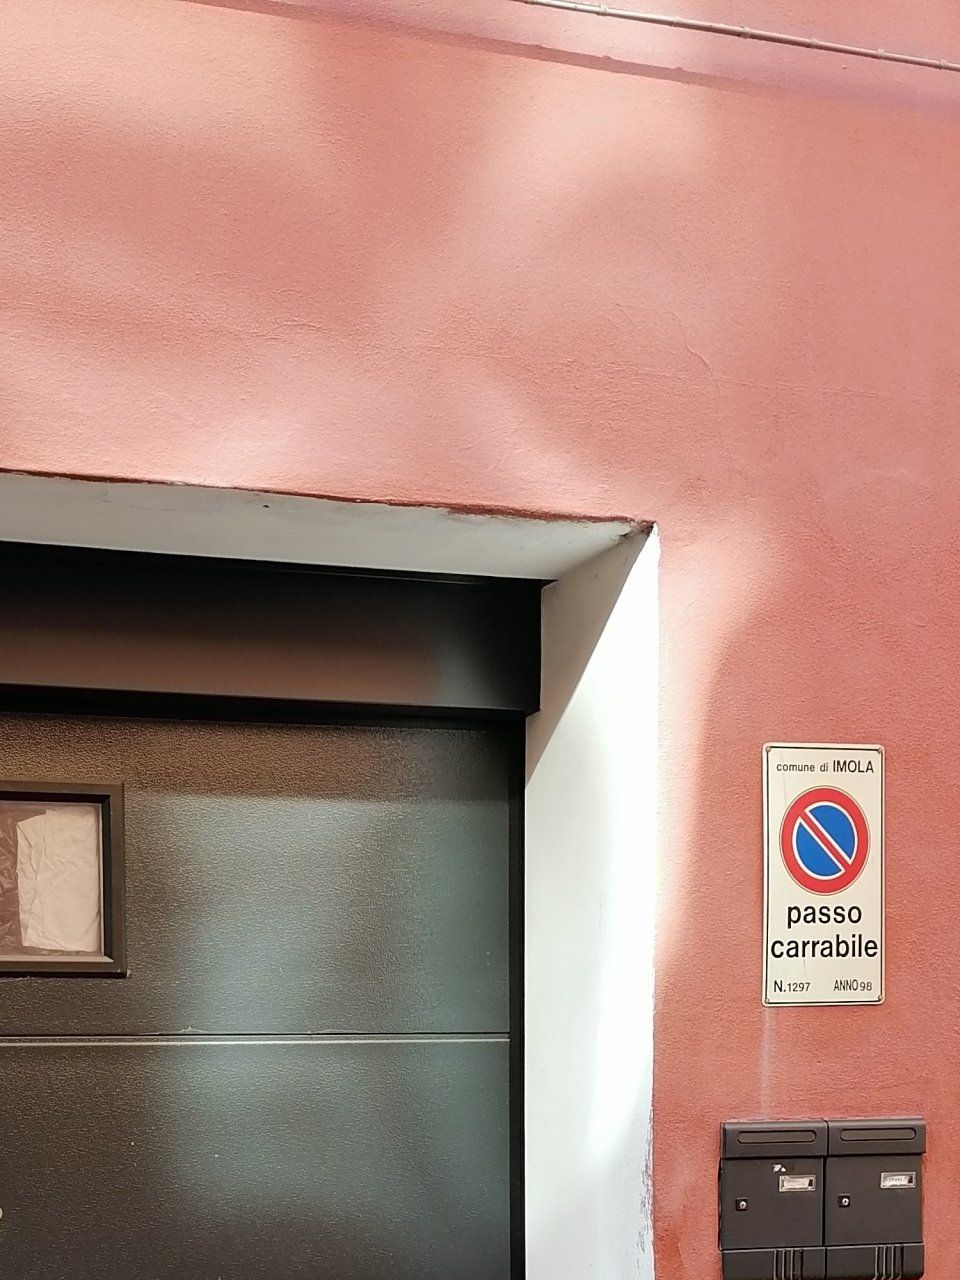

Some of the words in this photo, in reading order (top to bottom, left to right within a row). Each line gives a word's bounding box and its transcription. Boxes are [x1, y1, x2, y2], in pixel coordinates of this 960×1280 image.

[776, 763, 815, 772] comune
[819, 762, 828, 772] di
[832, 760, 874, 773] IMOLA
[787, 905, 862, 929] passo
[771, 934, 878, 958] carrabile
